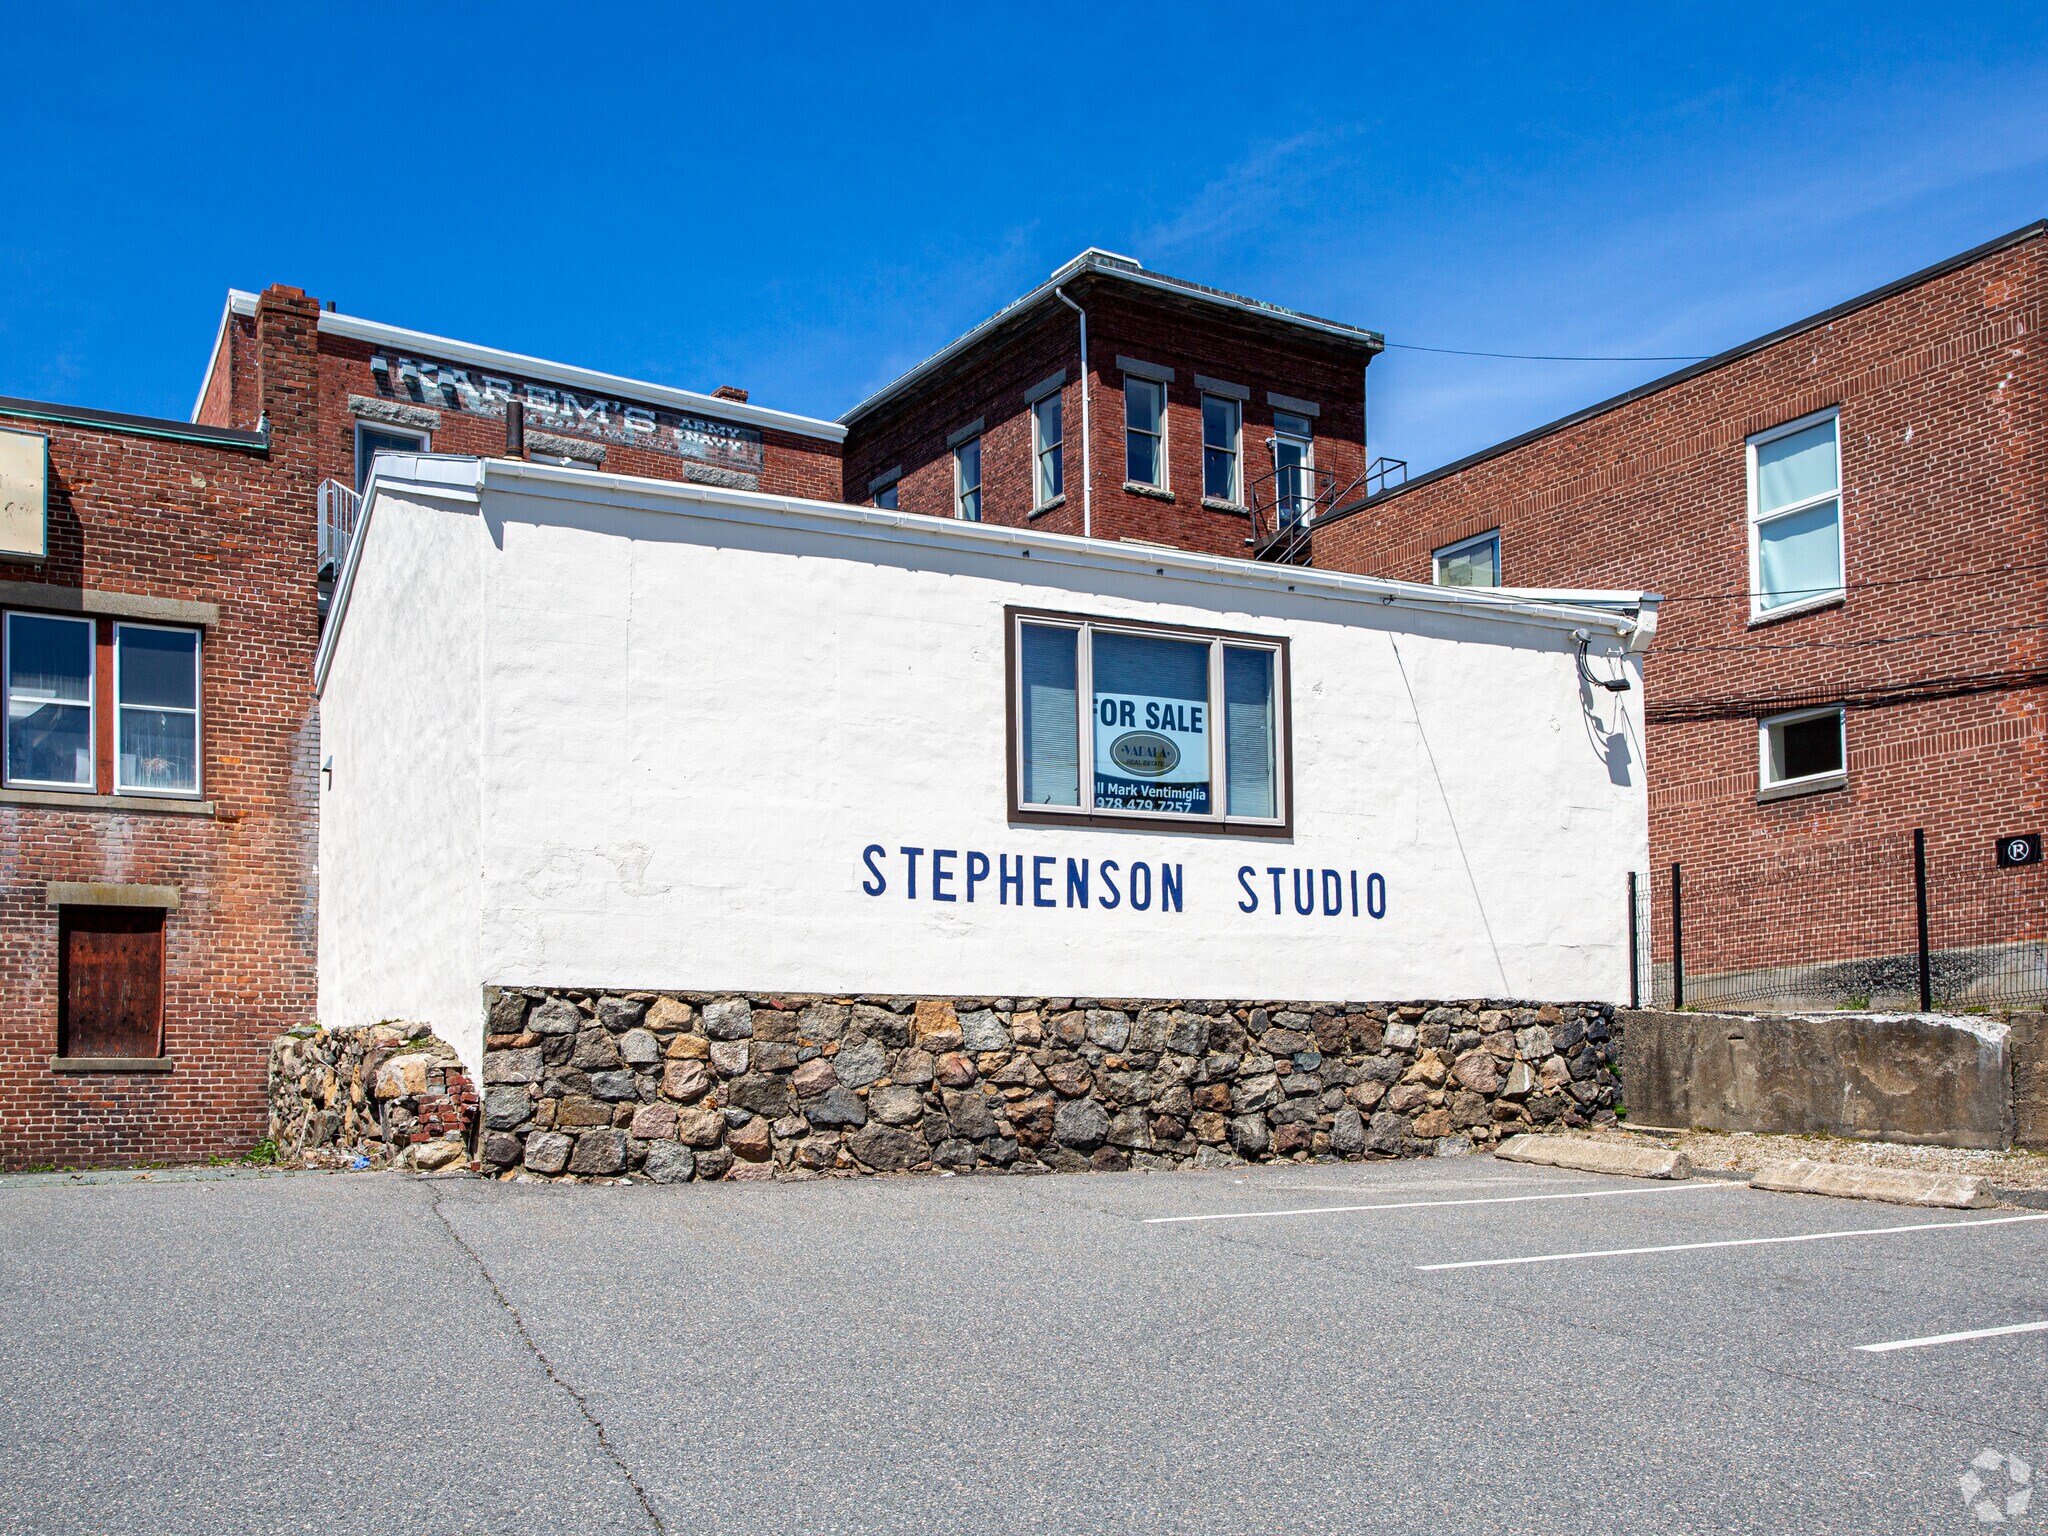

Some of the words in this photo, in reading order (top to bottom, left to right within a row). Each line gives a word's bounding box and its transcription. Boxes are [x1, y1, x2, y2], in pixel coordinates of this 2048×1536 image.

[679, 418, 741, 439] ARMY
[1146, 701, 1203, 733] SALE
[1126, 758, 1142, 766] REAL
[1142, 759, 1165, 768] ESTATE
[1107, 783, 1138, 797] Mark
[1140, 784, 1206, 802] Ventimiglia
[862, 844, 1184, 913] STEPHENSON
[1237, 864, 1387, 920] STUDIO
